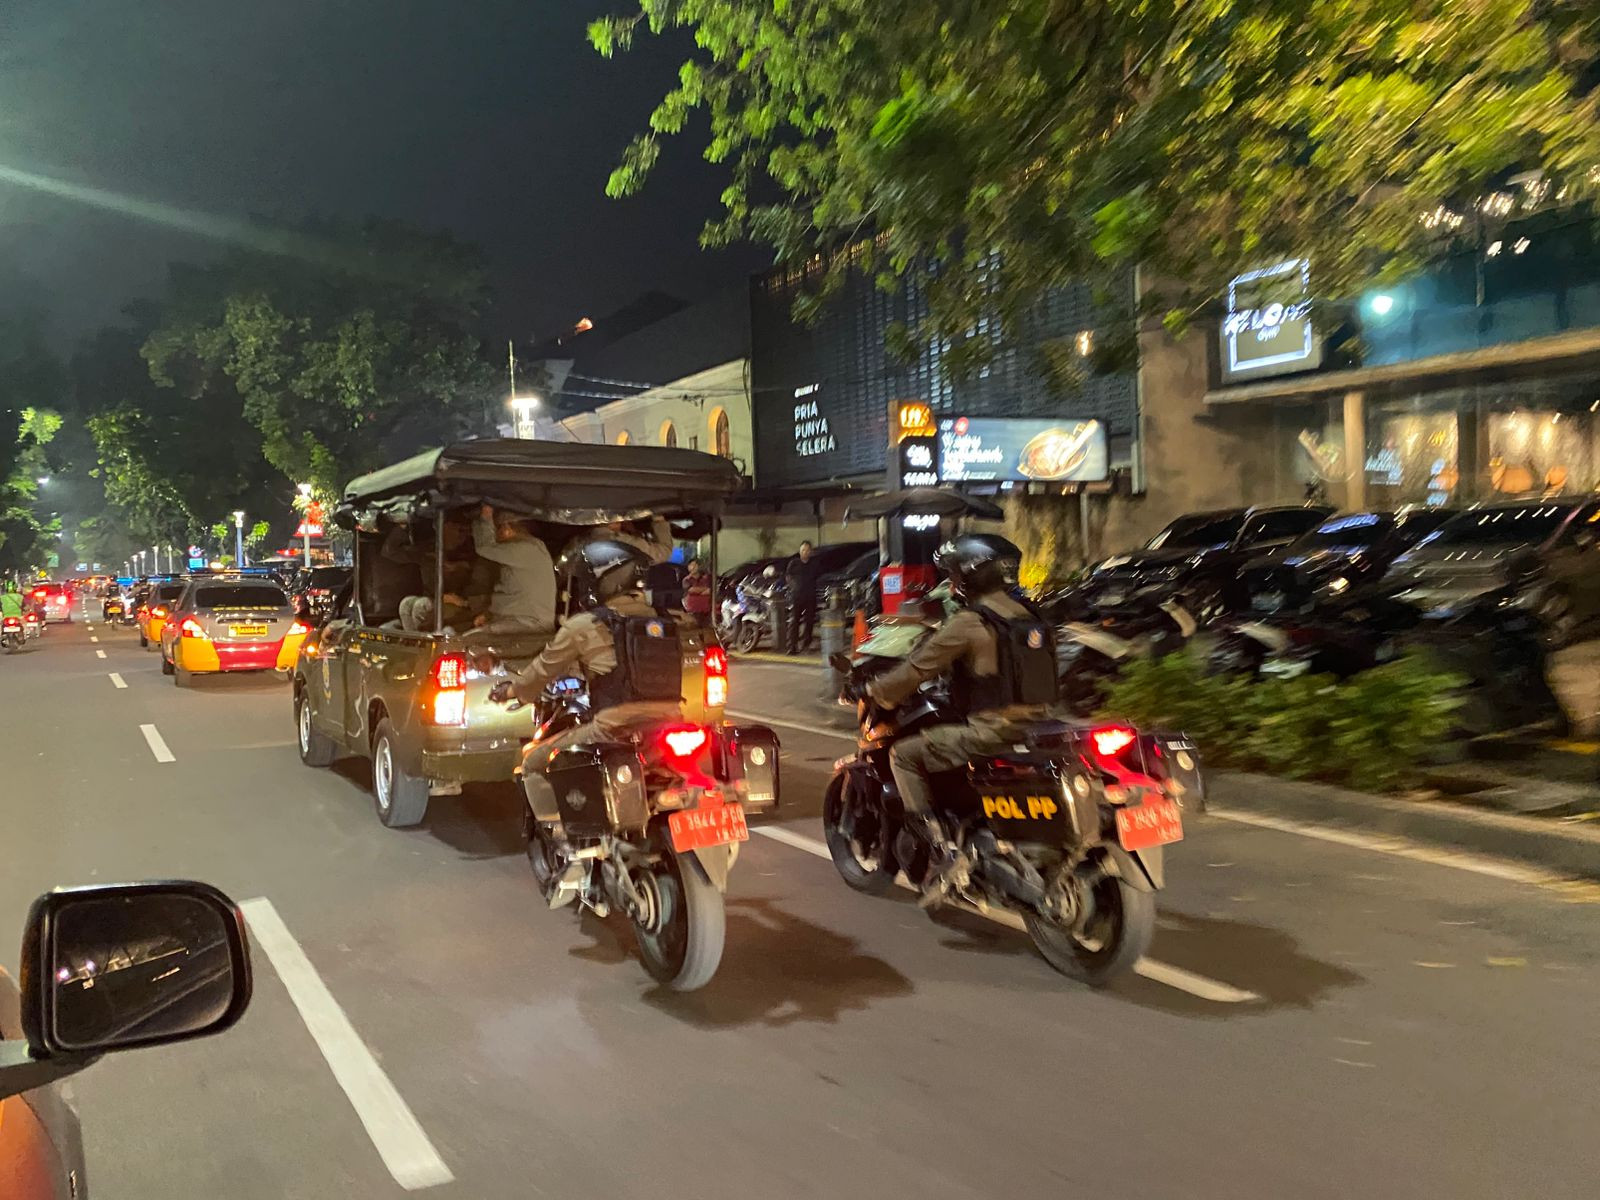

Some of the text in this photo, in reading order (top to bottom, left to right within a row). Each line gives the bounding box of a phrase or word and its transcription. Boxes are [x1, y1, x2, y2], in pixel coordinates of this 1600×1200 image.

[794, 400, 818, 422] PRIA
[795, 417, 828, 440] PUNYA
[795, 434, 835, 457] SELERA
[981, 795, 1058, 820] POL PP
